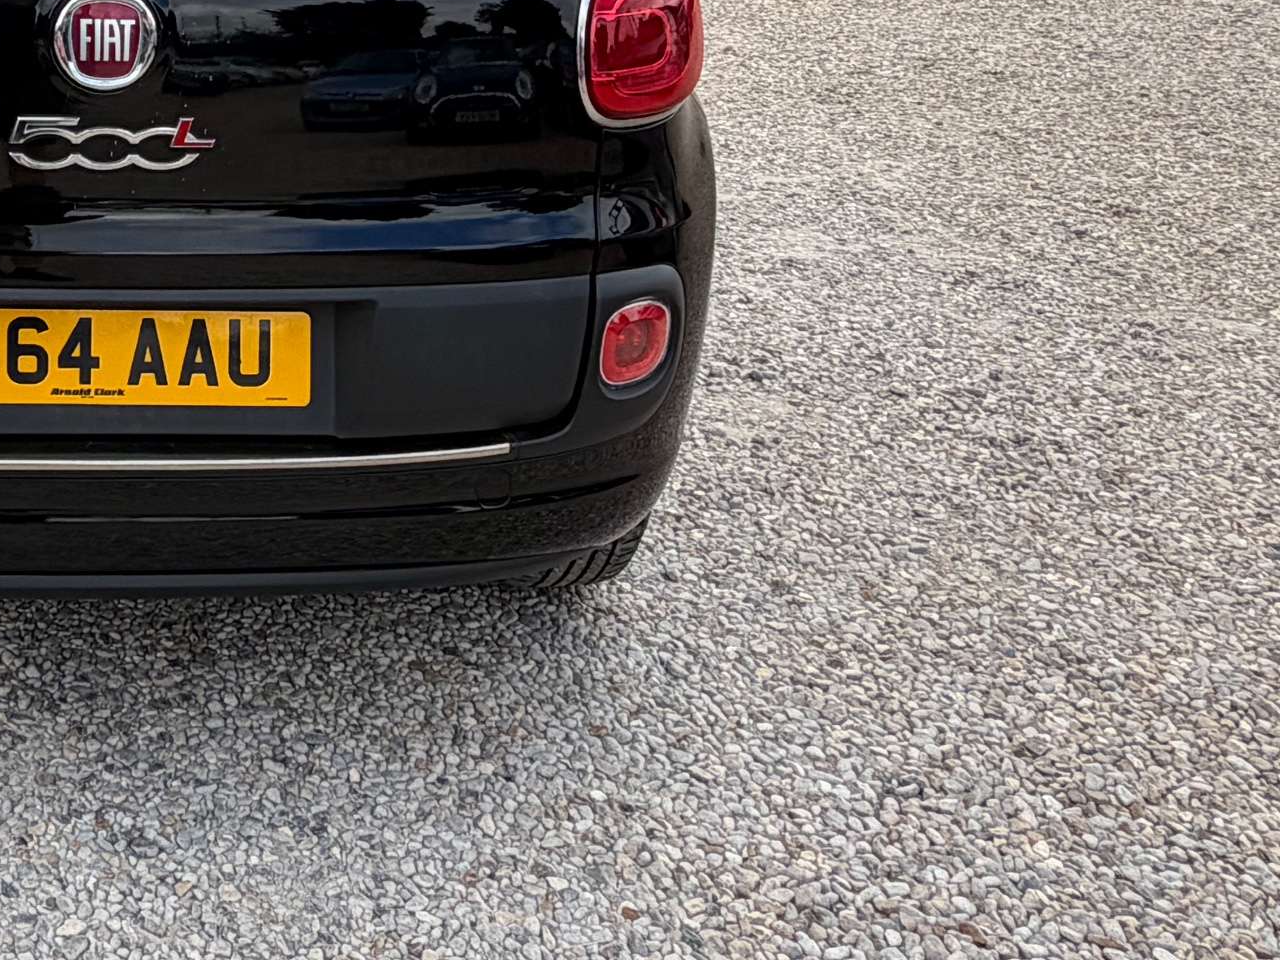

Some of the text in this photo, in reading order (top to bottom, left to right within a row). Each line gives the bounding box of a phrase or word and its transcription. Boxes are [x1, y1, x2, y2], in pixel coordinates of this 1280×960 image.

[79, 18, 136, 62] FIAT
[8, 116, 215, 171] 500L
[127, 317, 272, 387] AAU
[50, 388, 125, 396] Arnold Clark
